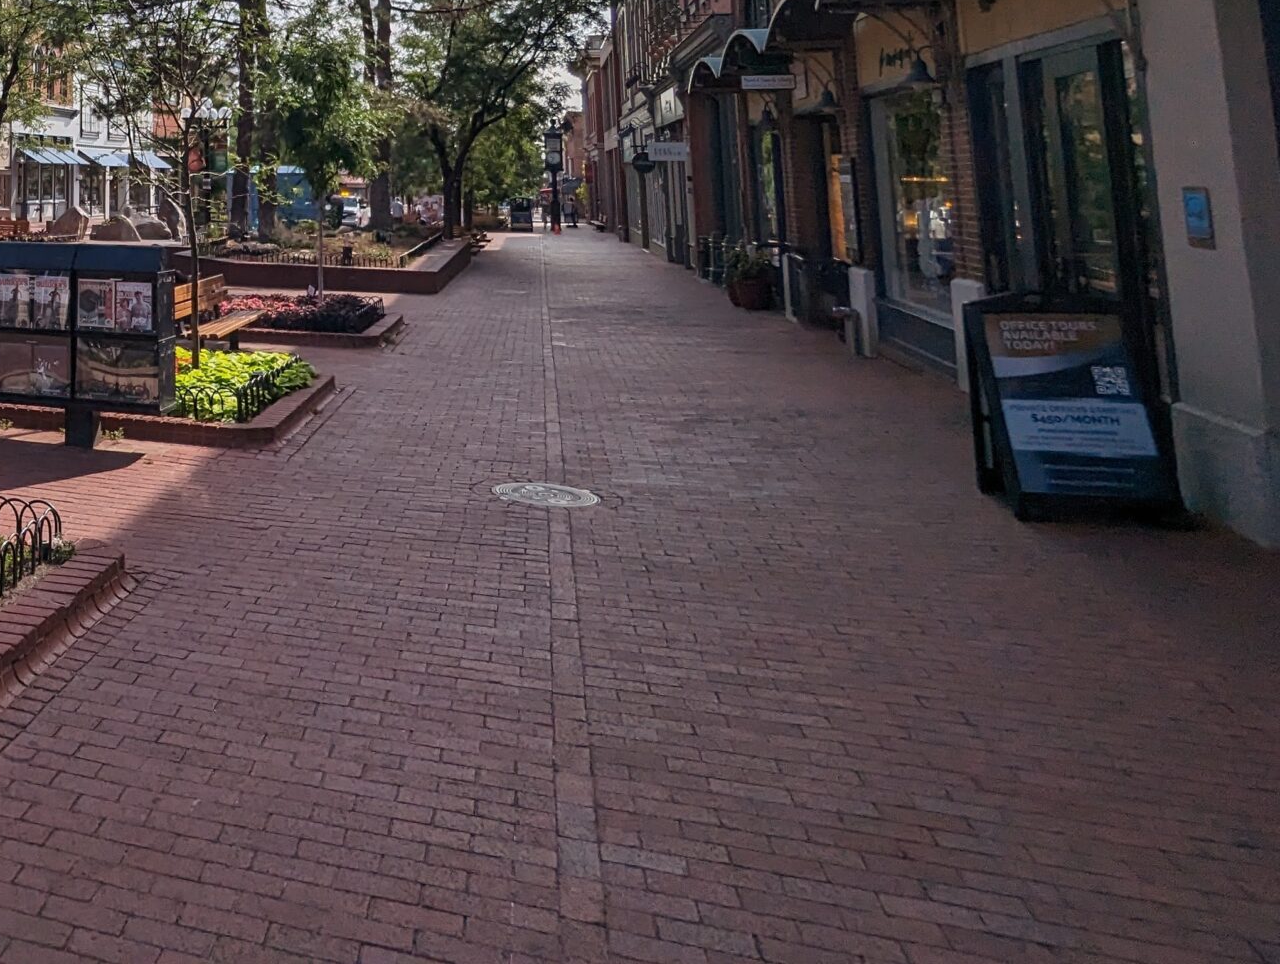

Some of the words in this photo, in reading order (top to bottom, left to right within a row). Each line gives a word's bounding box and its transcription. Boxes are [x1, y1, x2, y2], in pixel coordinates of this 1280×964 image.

[1000, 321, 1047, 331] OFFICE
[1051, 321, 1097, 331] TOURS
[1003, 330, 1079, 340] AVAILABLE
[1004, 340, 1055, 350] TODAY!
